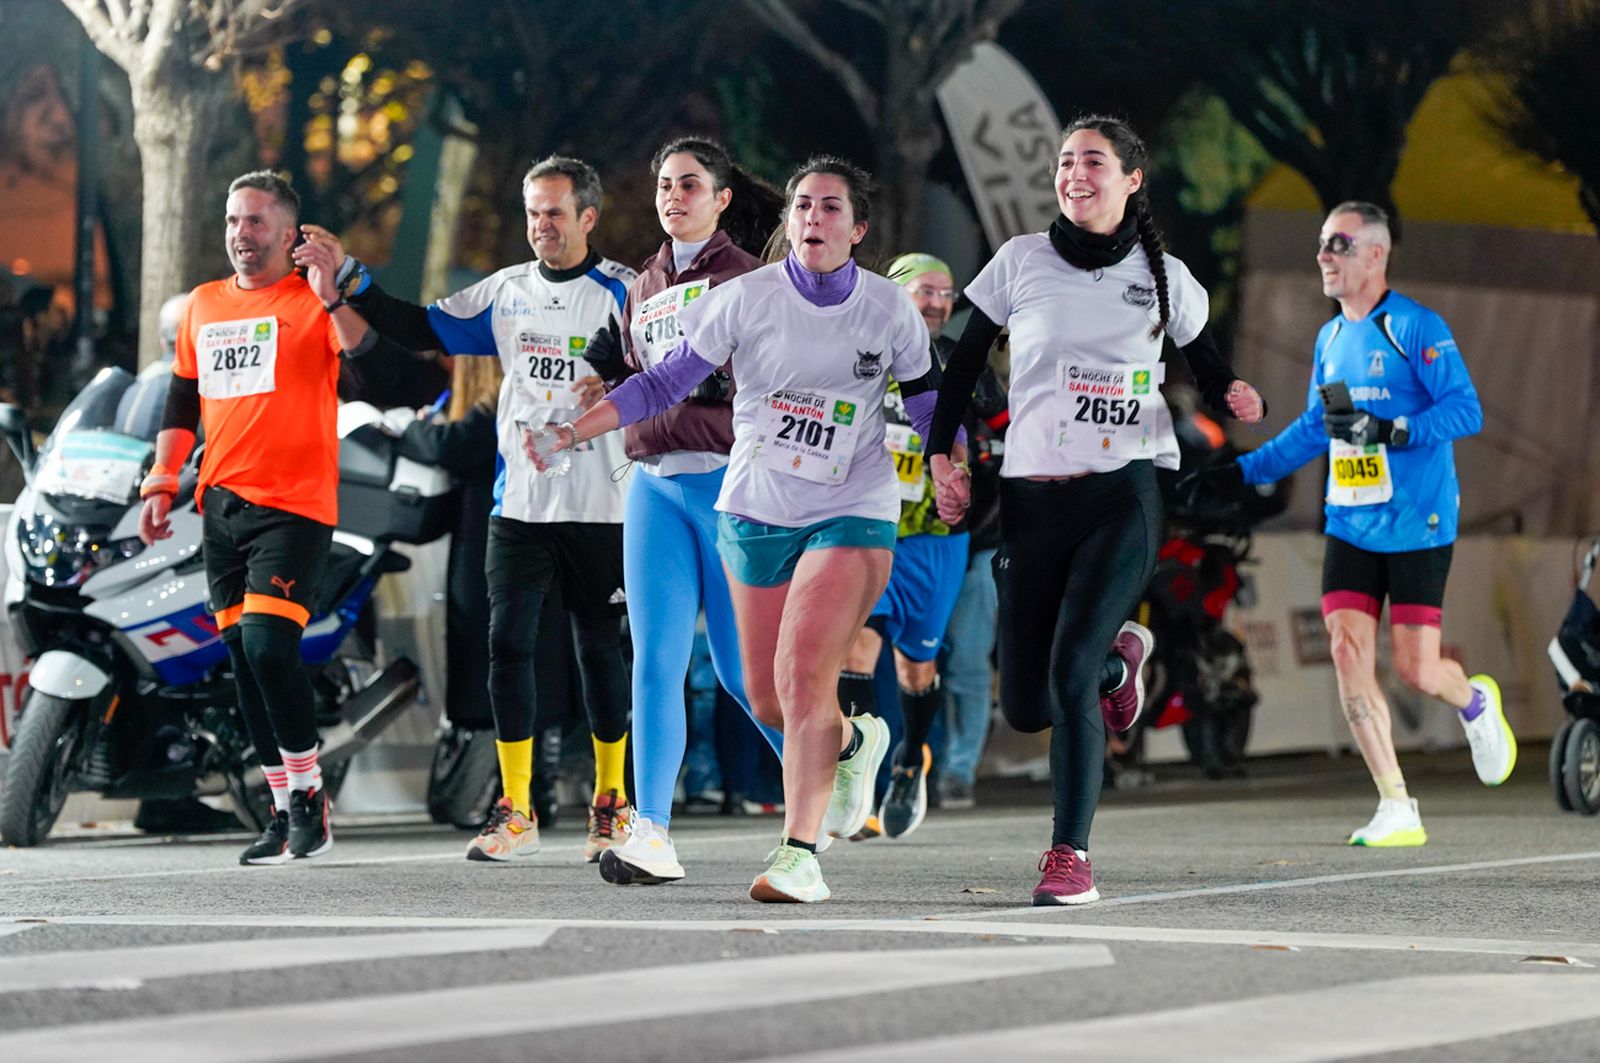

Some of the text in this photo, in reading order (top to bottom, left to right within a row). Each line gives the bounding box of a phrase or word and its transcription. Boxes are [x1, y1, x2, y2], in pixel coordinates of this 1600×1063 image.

[521, 344, 535, 353] SAN
[530, 335, 551, 344] NOCHE
[552, 338, 560, 346] DE
[212, 344, 261, 372] 2822
[529, 356, 575, 382] 2821
[1081, 370, 1111, 383] NOCHE
[1112, 376, 1124, 384] DE
[1069, 382, 1089, 392] SAN
[1090, 384, 1124, 396] ANTÓN
[783, 391, 813, 405] NOCHE
[813, 399, 826, 408] DE
[771, 400, 790, 412] SAN
[791, 405, 824, 420] ANTÓN
[1074, 395, 1140, 426] 2652
[776, 414, 836, 451] 2101
